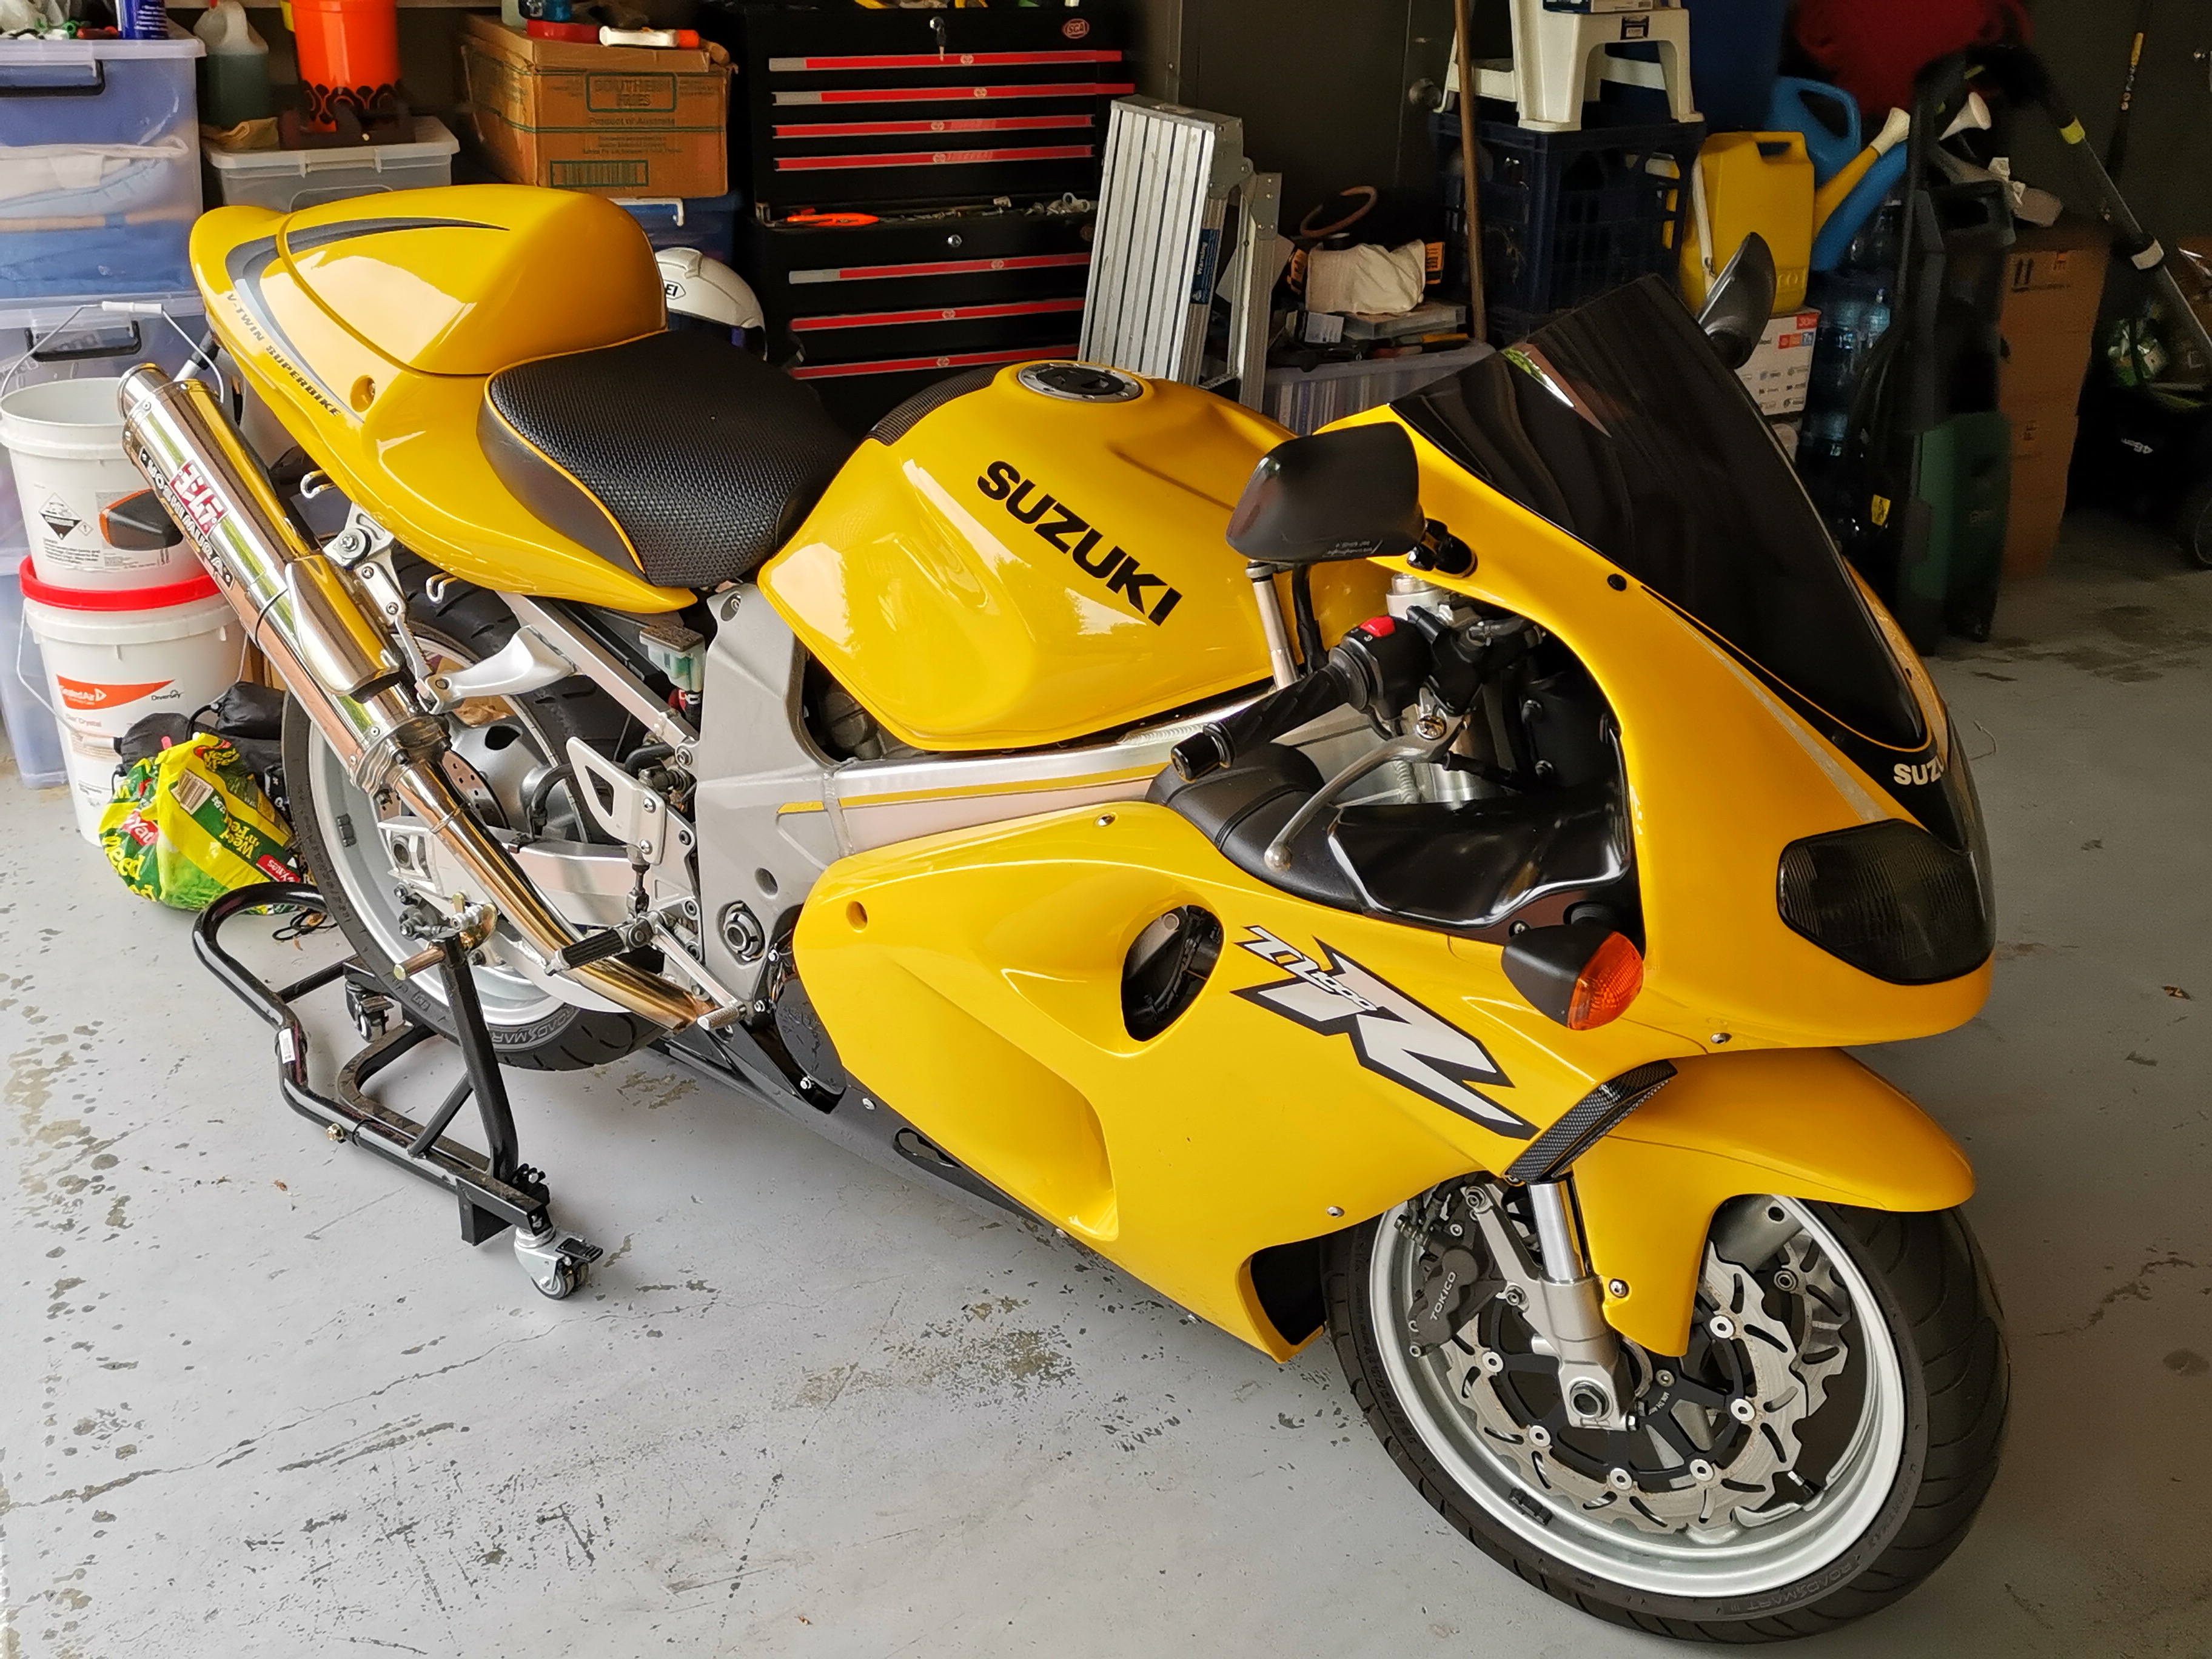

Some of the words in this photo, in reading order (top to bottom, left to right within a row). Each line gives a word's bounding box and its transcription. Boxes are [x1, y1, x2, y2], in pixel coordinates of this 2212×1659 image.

[227, 293, 265, 341] V-TWIN
[266, 345, 341, 416] SUPERBIKE
[147, 459, 223, 575] YOSHIMURA
[977, 460, 1182, 626] SUZUKI
[1430, 1272, 1456, 1320] TOKICO
